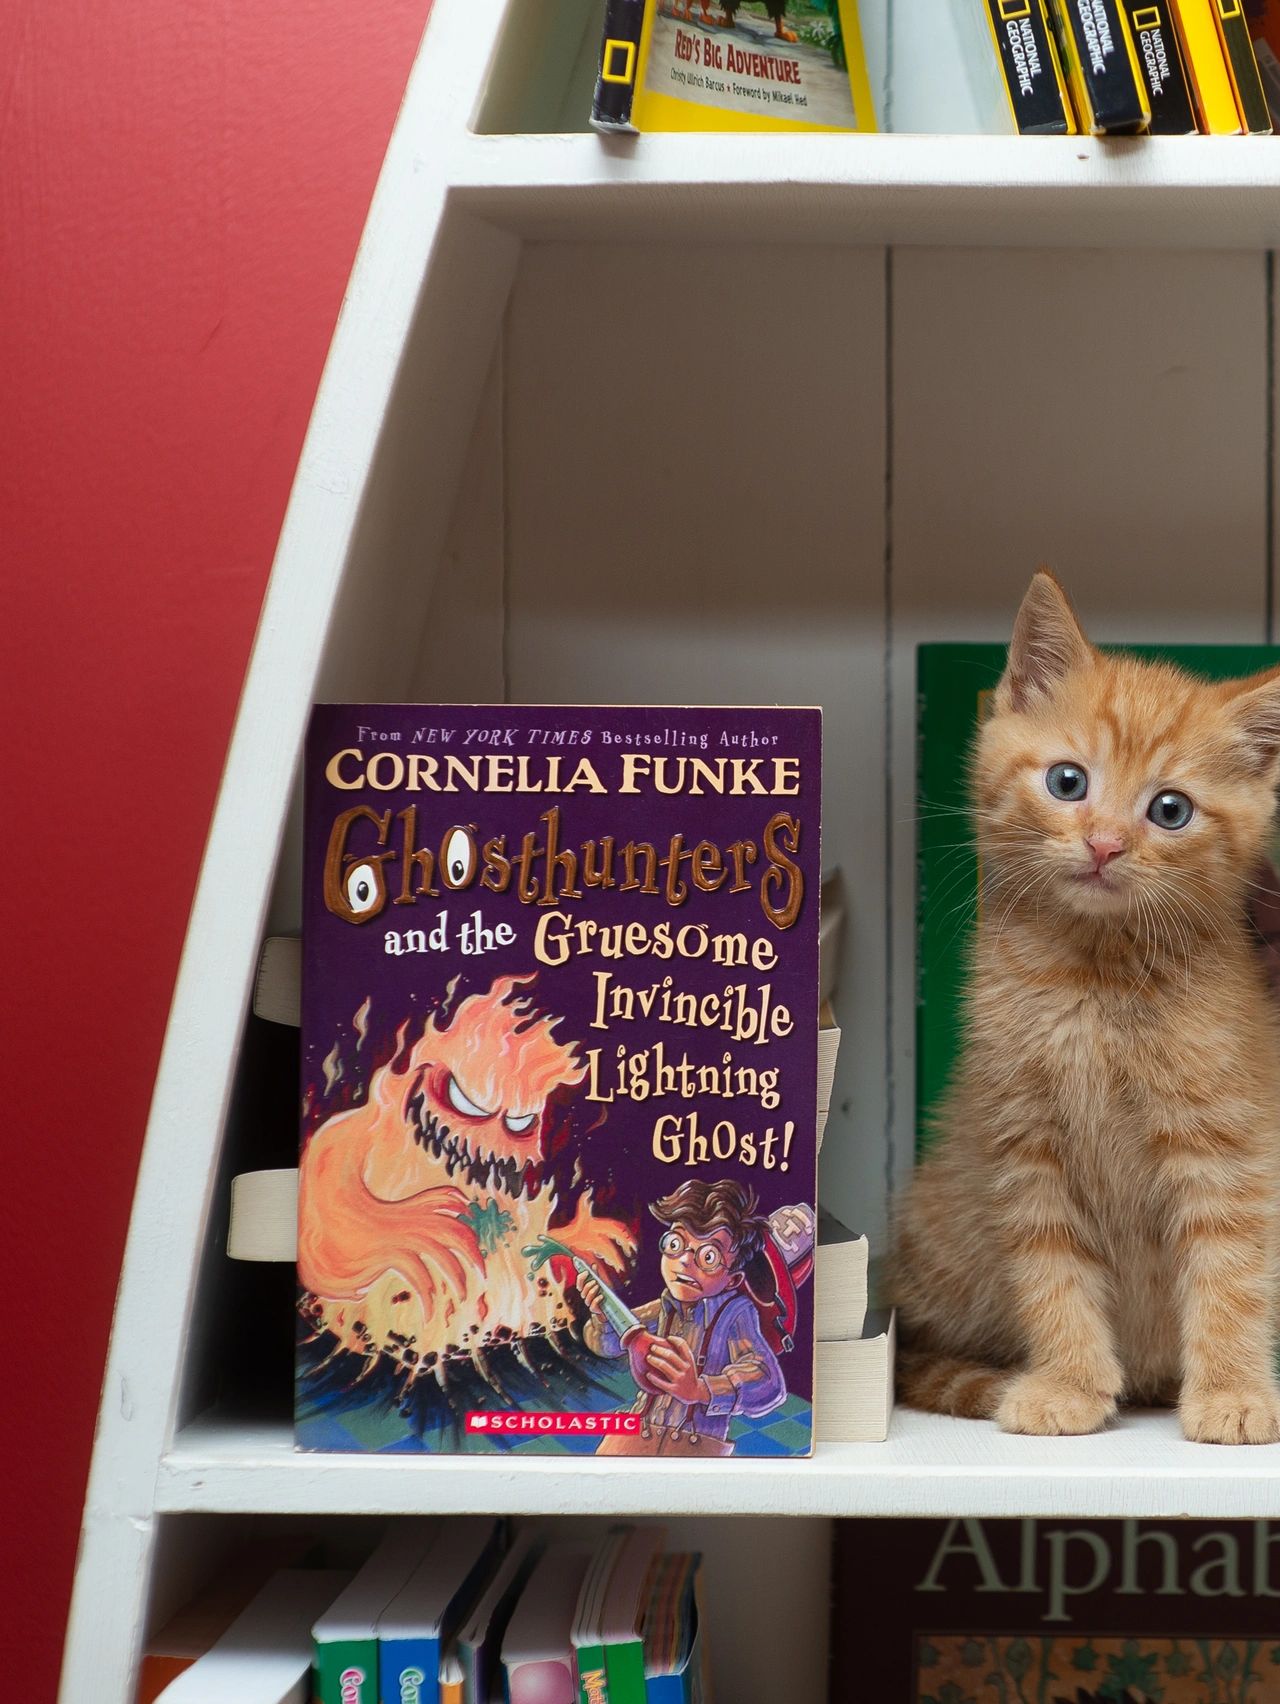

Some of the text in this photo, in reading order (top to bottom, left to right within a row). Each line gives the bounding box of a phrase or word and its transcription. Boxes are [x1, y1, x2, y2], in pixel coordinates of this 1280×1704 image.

[675, 28, 802, 84] RED'S BIG ADVENTURE
[1006, 20, 1034, 97] GEOGRAPHIC
[1019, 17, 1042, 79] NATIONAL
[1139, 30, 1164, 96] GEOGRAPHIC
[1151, 28, 1171, 81] NATIONAL
[705, 76, 725, 92] Barcus
[733, 83, 761, 100] Foreword
[762, 88, 771, 103] by
[356, 725, 779, 749] From NEW YORK TIMES Bestselling Author
[325, 749, 800, 795] CORNELIA FUNKE
[384, 910, 778, 970] and the Gruesome
[590, 971, 794, 1045] Invincible
[585, 1042, 781, 1109] Lightning
[653, 1112, 795, 1172] Ghost!
[490, 1415, 637, 1430] SCHOLASTIC
